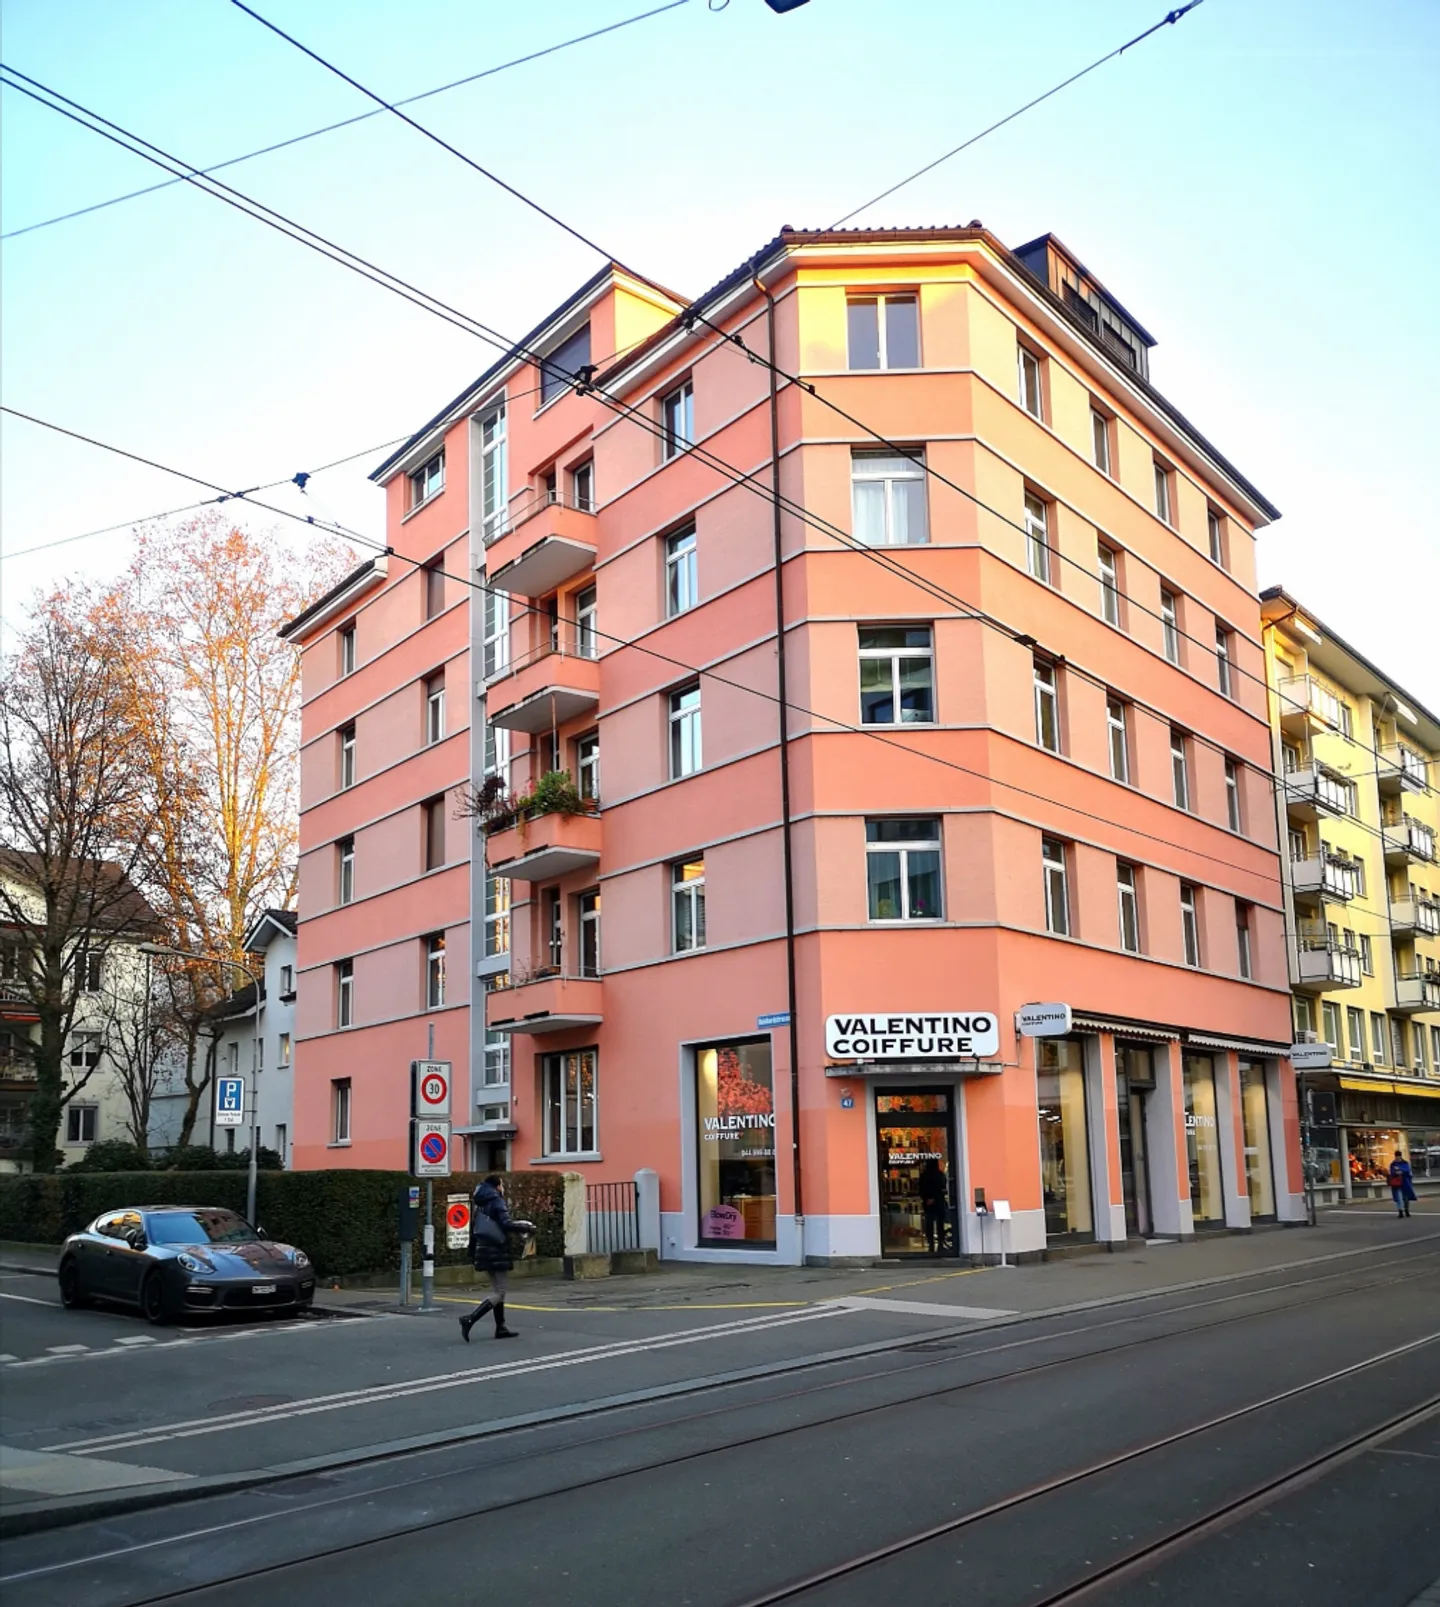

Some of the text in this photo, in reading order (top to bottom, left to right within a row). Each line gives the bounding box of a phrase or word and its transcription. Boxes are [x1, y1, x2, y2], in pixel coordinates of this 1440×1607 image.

[1021, 1013, 1066, 1022] VALENTINO
[834, 1016, 992, 1035] VALENTINO
[833, 1037, 973, 1054] COIFFURE
[426, 1065, 442, 1073] ZONE
[226, 1082, 237, 1097] P
[428, 1083, 440, 1095] 30
[842, 1099, 853, 1107] 47
[1185, 1115, 1215, 1127] LENTINO
[425, 1124, 442, 1132] ZONE
[704, 1132, 740, 1141] COIFFURE
[888, 1152, 943, 1161] VALENTINO
